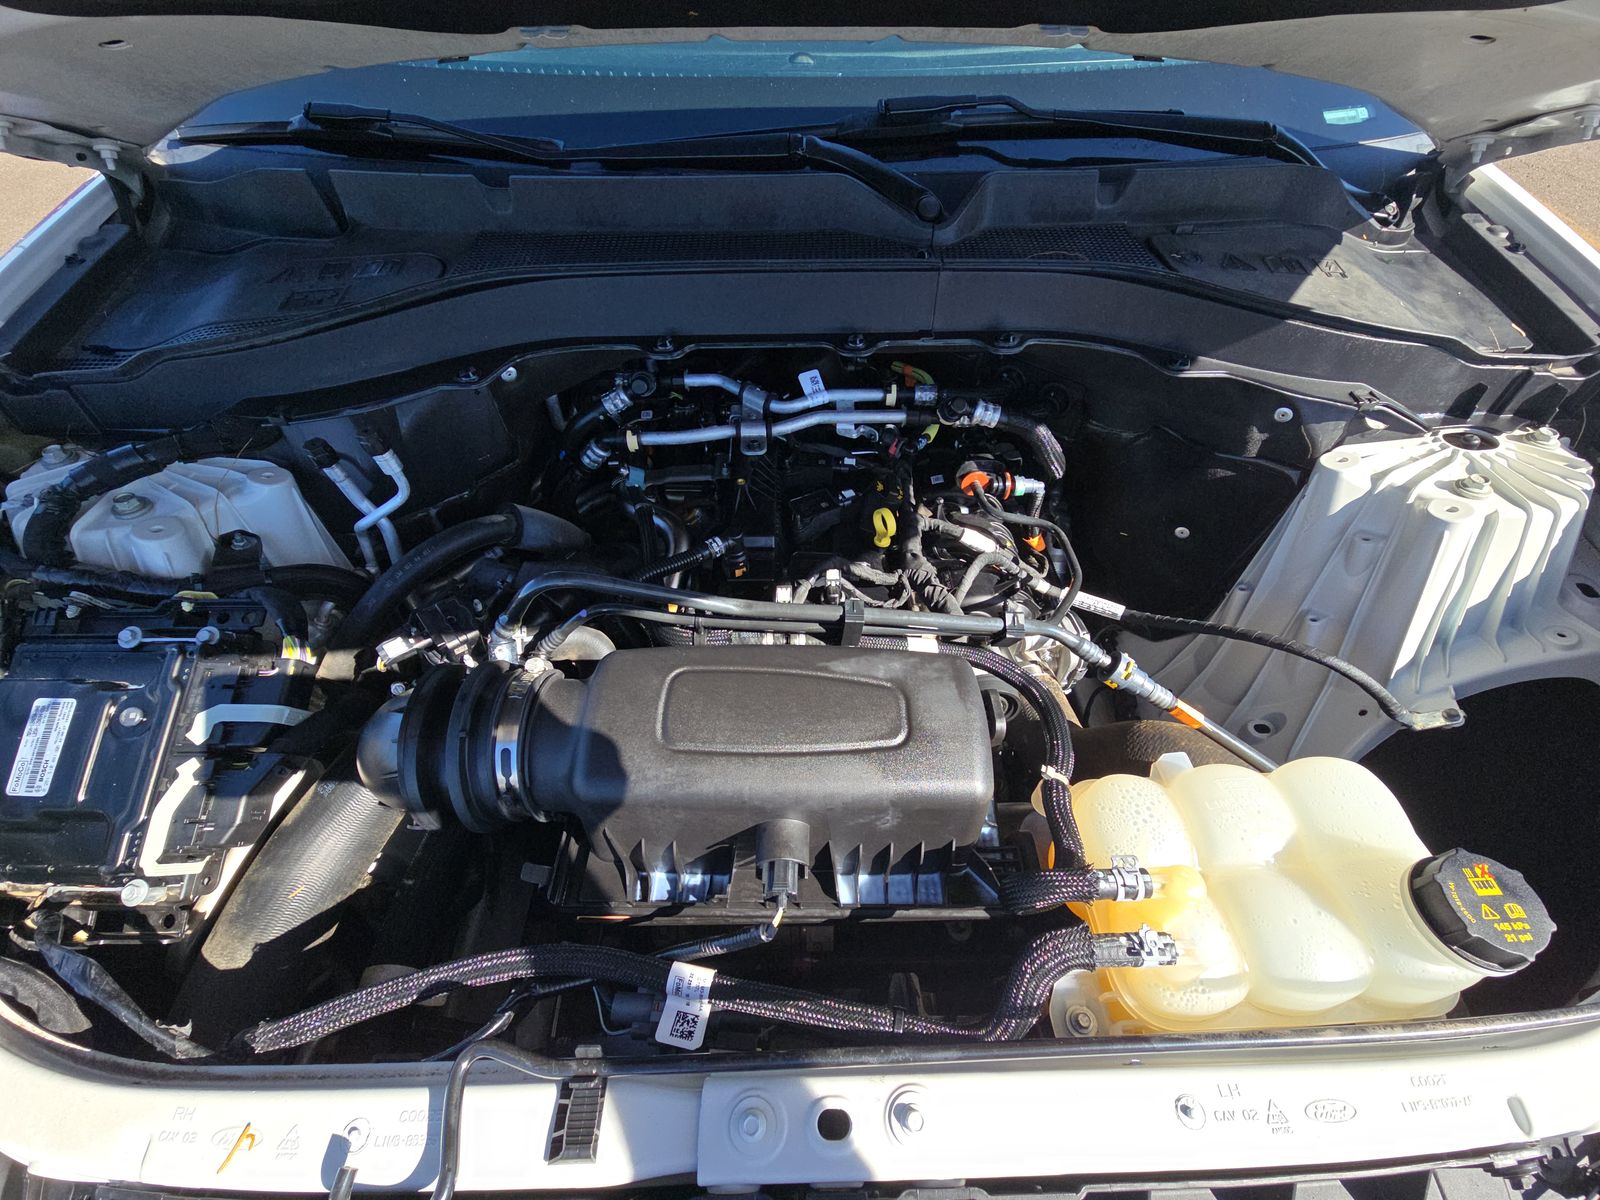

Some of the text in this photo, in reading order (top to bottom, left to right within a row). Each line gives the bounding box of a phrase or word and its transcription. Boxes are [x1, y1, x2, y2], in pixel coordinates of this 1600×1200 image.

[12, 762, 26, 792] FoMoCo
[38, 759, 50, 783] BOSCH
[1494, 921, 1531, 931] 145 kPa
[1504, 932, 1534, 943] 21 psi
[1217, 1083, 1241, 1099] LH
[172, 1106, 197, 1121] RH
[1311, 1101, 1349, 1121] Ford
